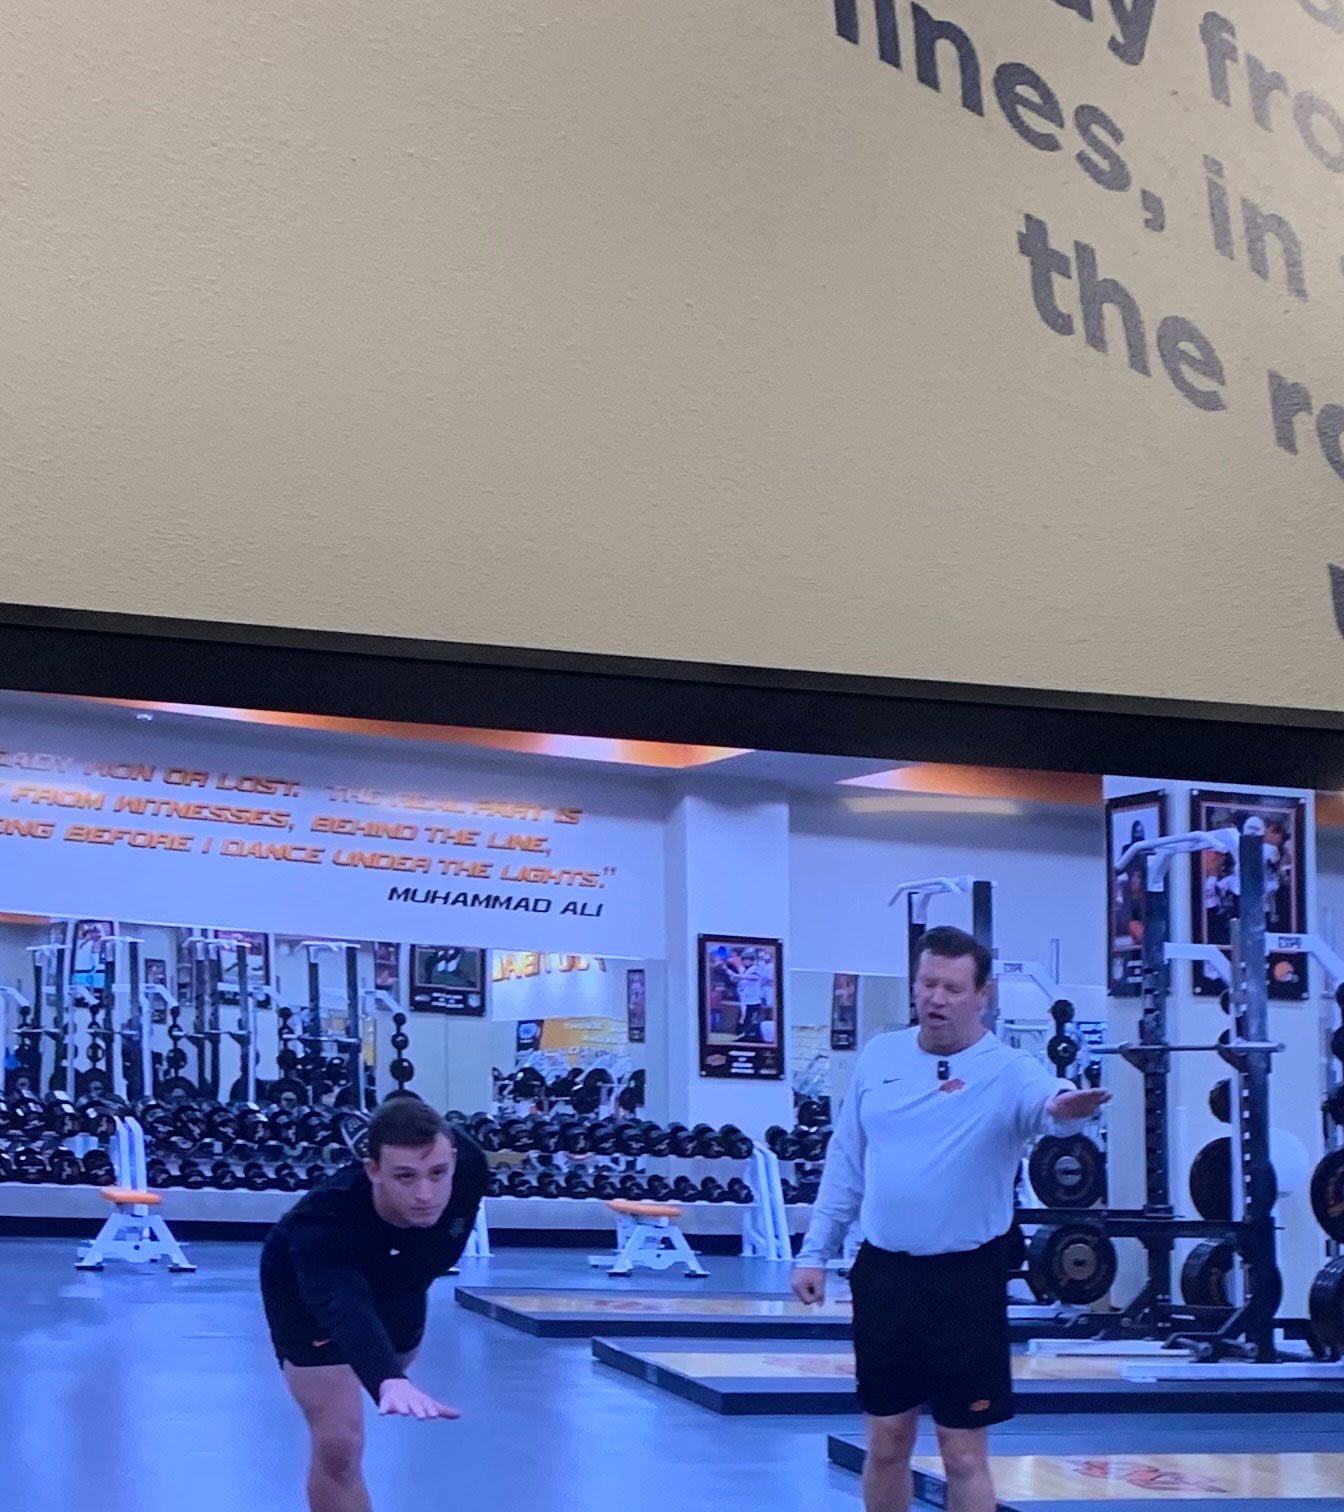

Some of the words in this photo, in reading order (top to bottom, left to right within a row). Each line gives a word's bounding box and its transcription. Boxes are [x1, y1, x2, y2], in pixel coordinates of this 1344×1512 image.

[1203, 153, 1309, 302] in
[1016, 211, 1228, 412] the
[9, 783, 106, 812] FROM
[113, 794, 296, 834] WITNESSES,
[310, 815, 420, 842] BEHIND
[424, 826, 482, 848] THE
[485, 831, 553, 858] LINE,
[162, 766, 211, 788] OR
[216, 772, 301, 798] LOST.
[325, 784, 385, 806] THE
[471, 798, 550, 823] PART
[552, 805, 584, 825] IS
[63, 823, 195, 852] BEFORE
[201, 837, 213, 854] I
[219, 838, 327, 865] DANCE
[331, 848, 434, 875] UNDER
[437, 858, 494, 879] THE
[387, 885, 553, 913] MUHAMMAD
[560, 900, 605, 918] ALI
